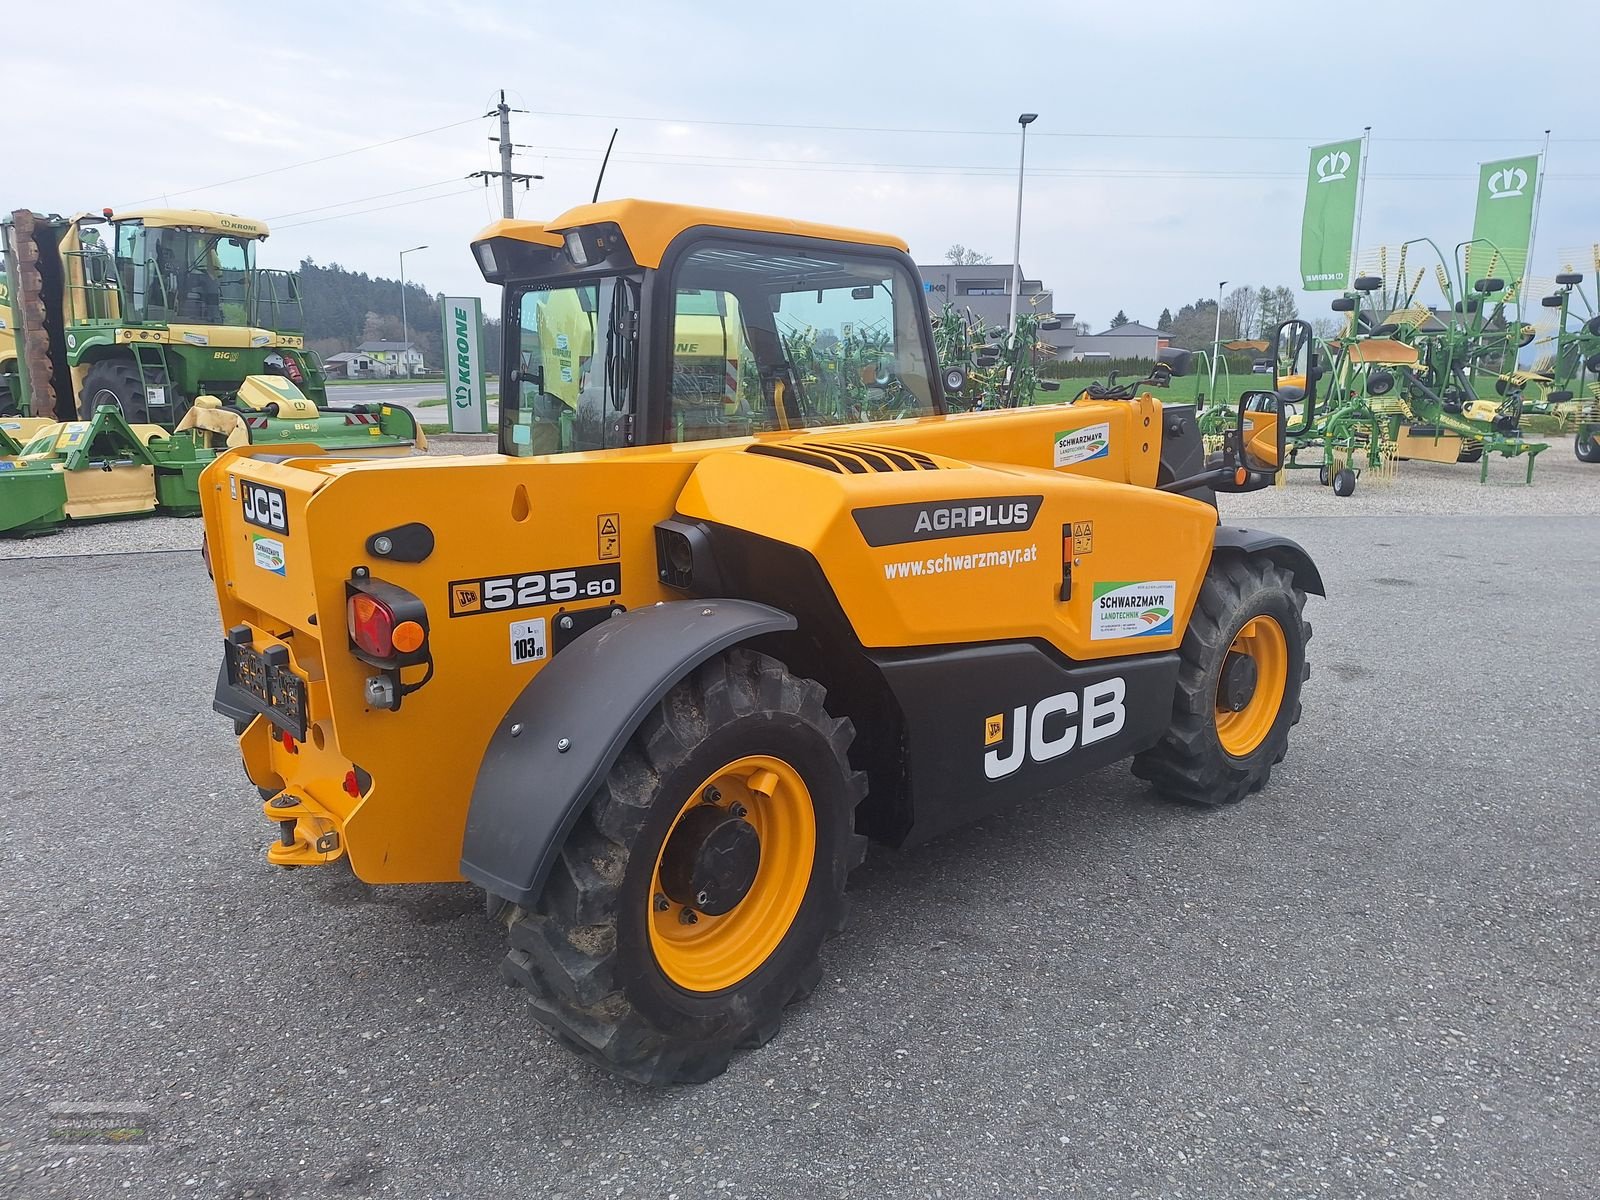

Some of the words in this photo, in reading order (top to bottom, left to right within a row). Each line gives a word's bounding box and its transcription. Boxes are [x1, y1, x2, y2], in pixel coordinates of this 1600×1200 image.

[231, 223, 257, 231] KRONE
[455, 307, 471, 385] KRONE
[1059, 432, 1103, 448] SCHWARZMAYR
[244, 486, 285, 528] JCB
[884, 544, 1037, 580] www.schwarzmayr.at
[460, 590, 477, 605] JCB
[1100, 595, 1164, 609] SCHWARZMAYR
[1100, 611, 1140, 620] LANDTECHNIK
[514, 637, 535, 660] 103
[984, 676, 1126, 779] JCB
